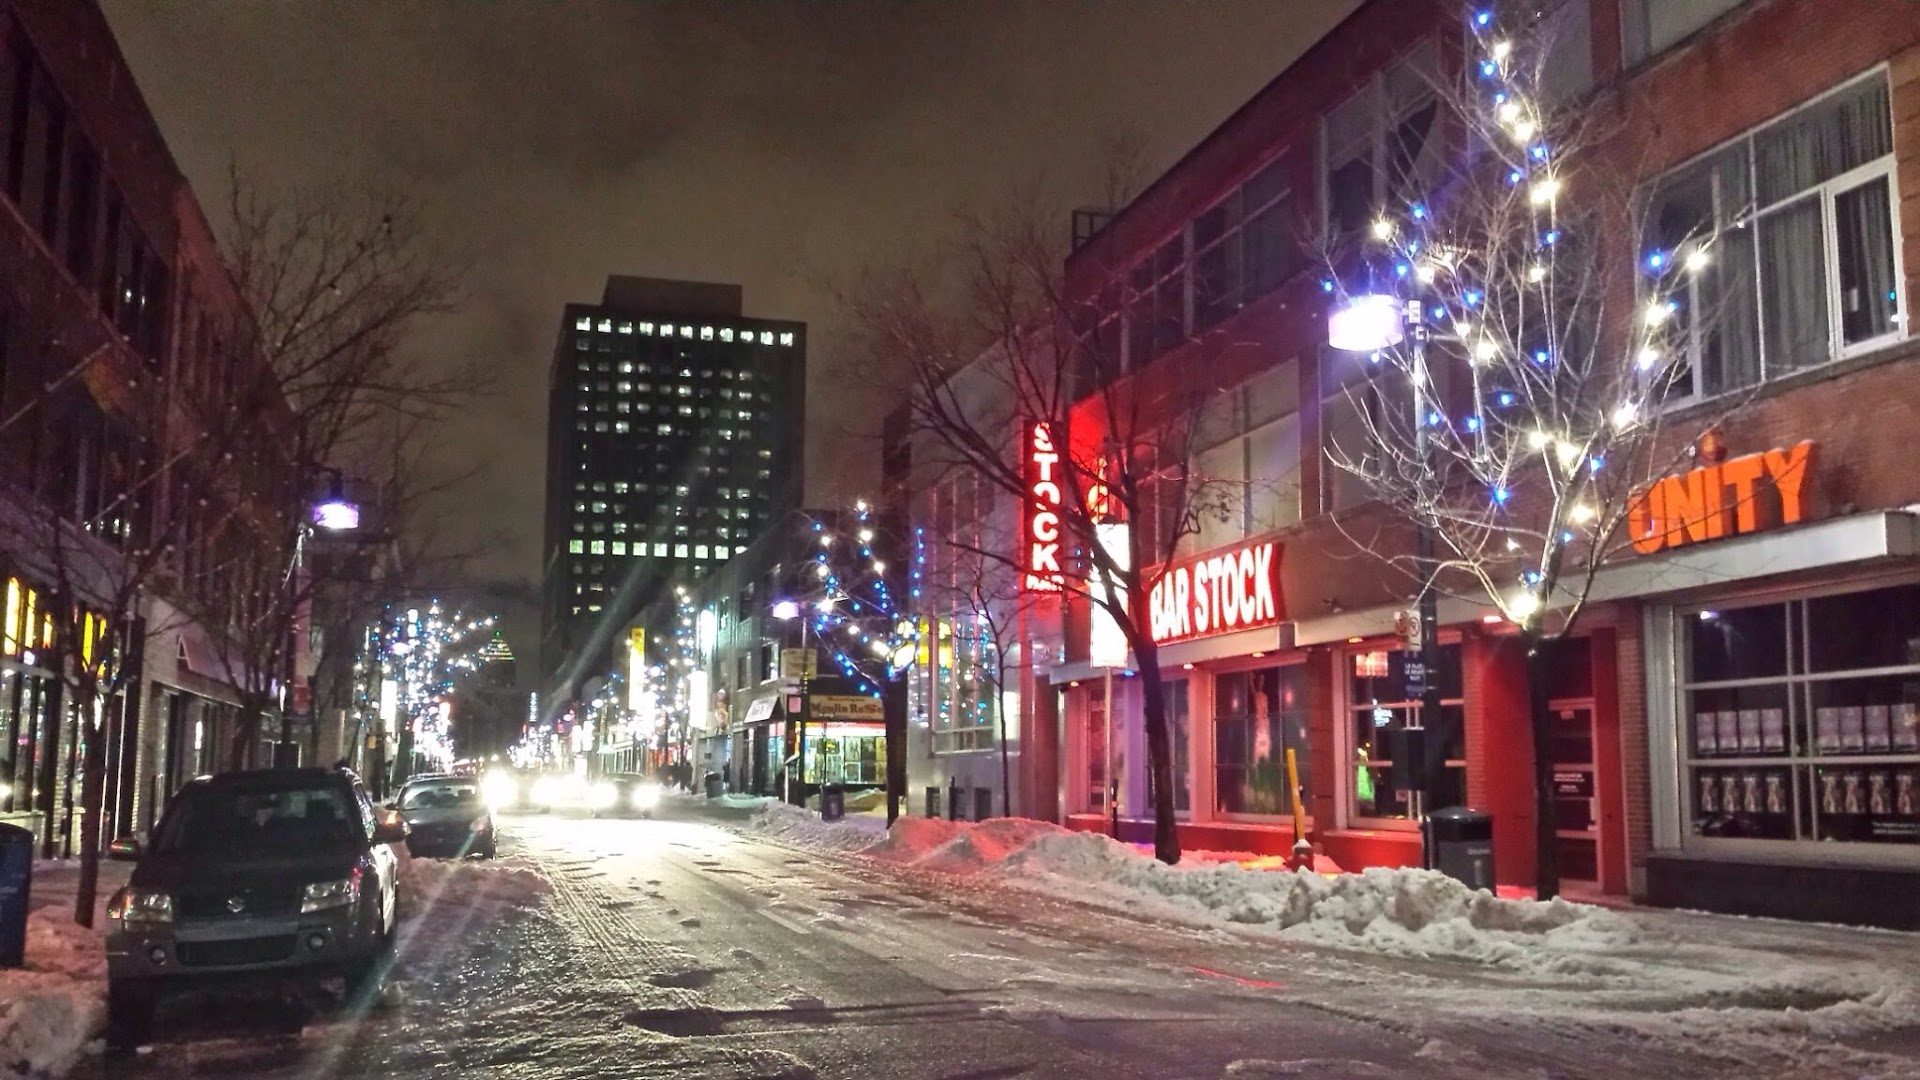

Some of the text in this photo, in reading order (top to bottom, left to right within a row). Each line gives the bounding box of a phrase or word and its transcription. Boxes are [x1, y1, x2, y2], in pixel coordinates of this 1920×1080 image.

[1032, 421, 1061, 572] STOCK
[1628, 439, 1815, 554] UNITY
[1150, 542, 1276, 641] BAR STOCK
